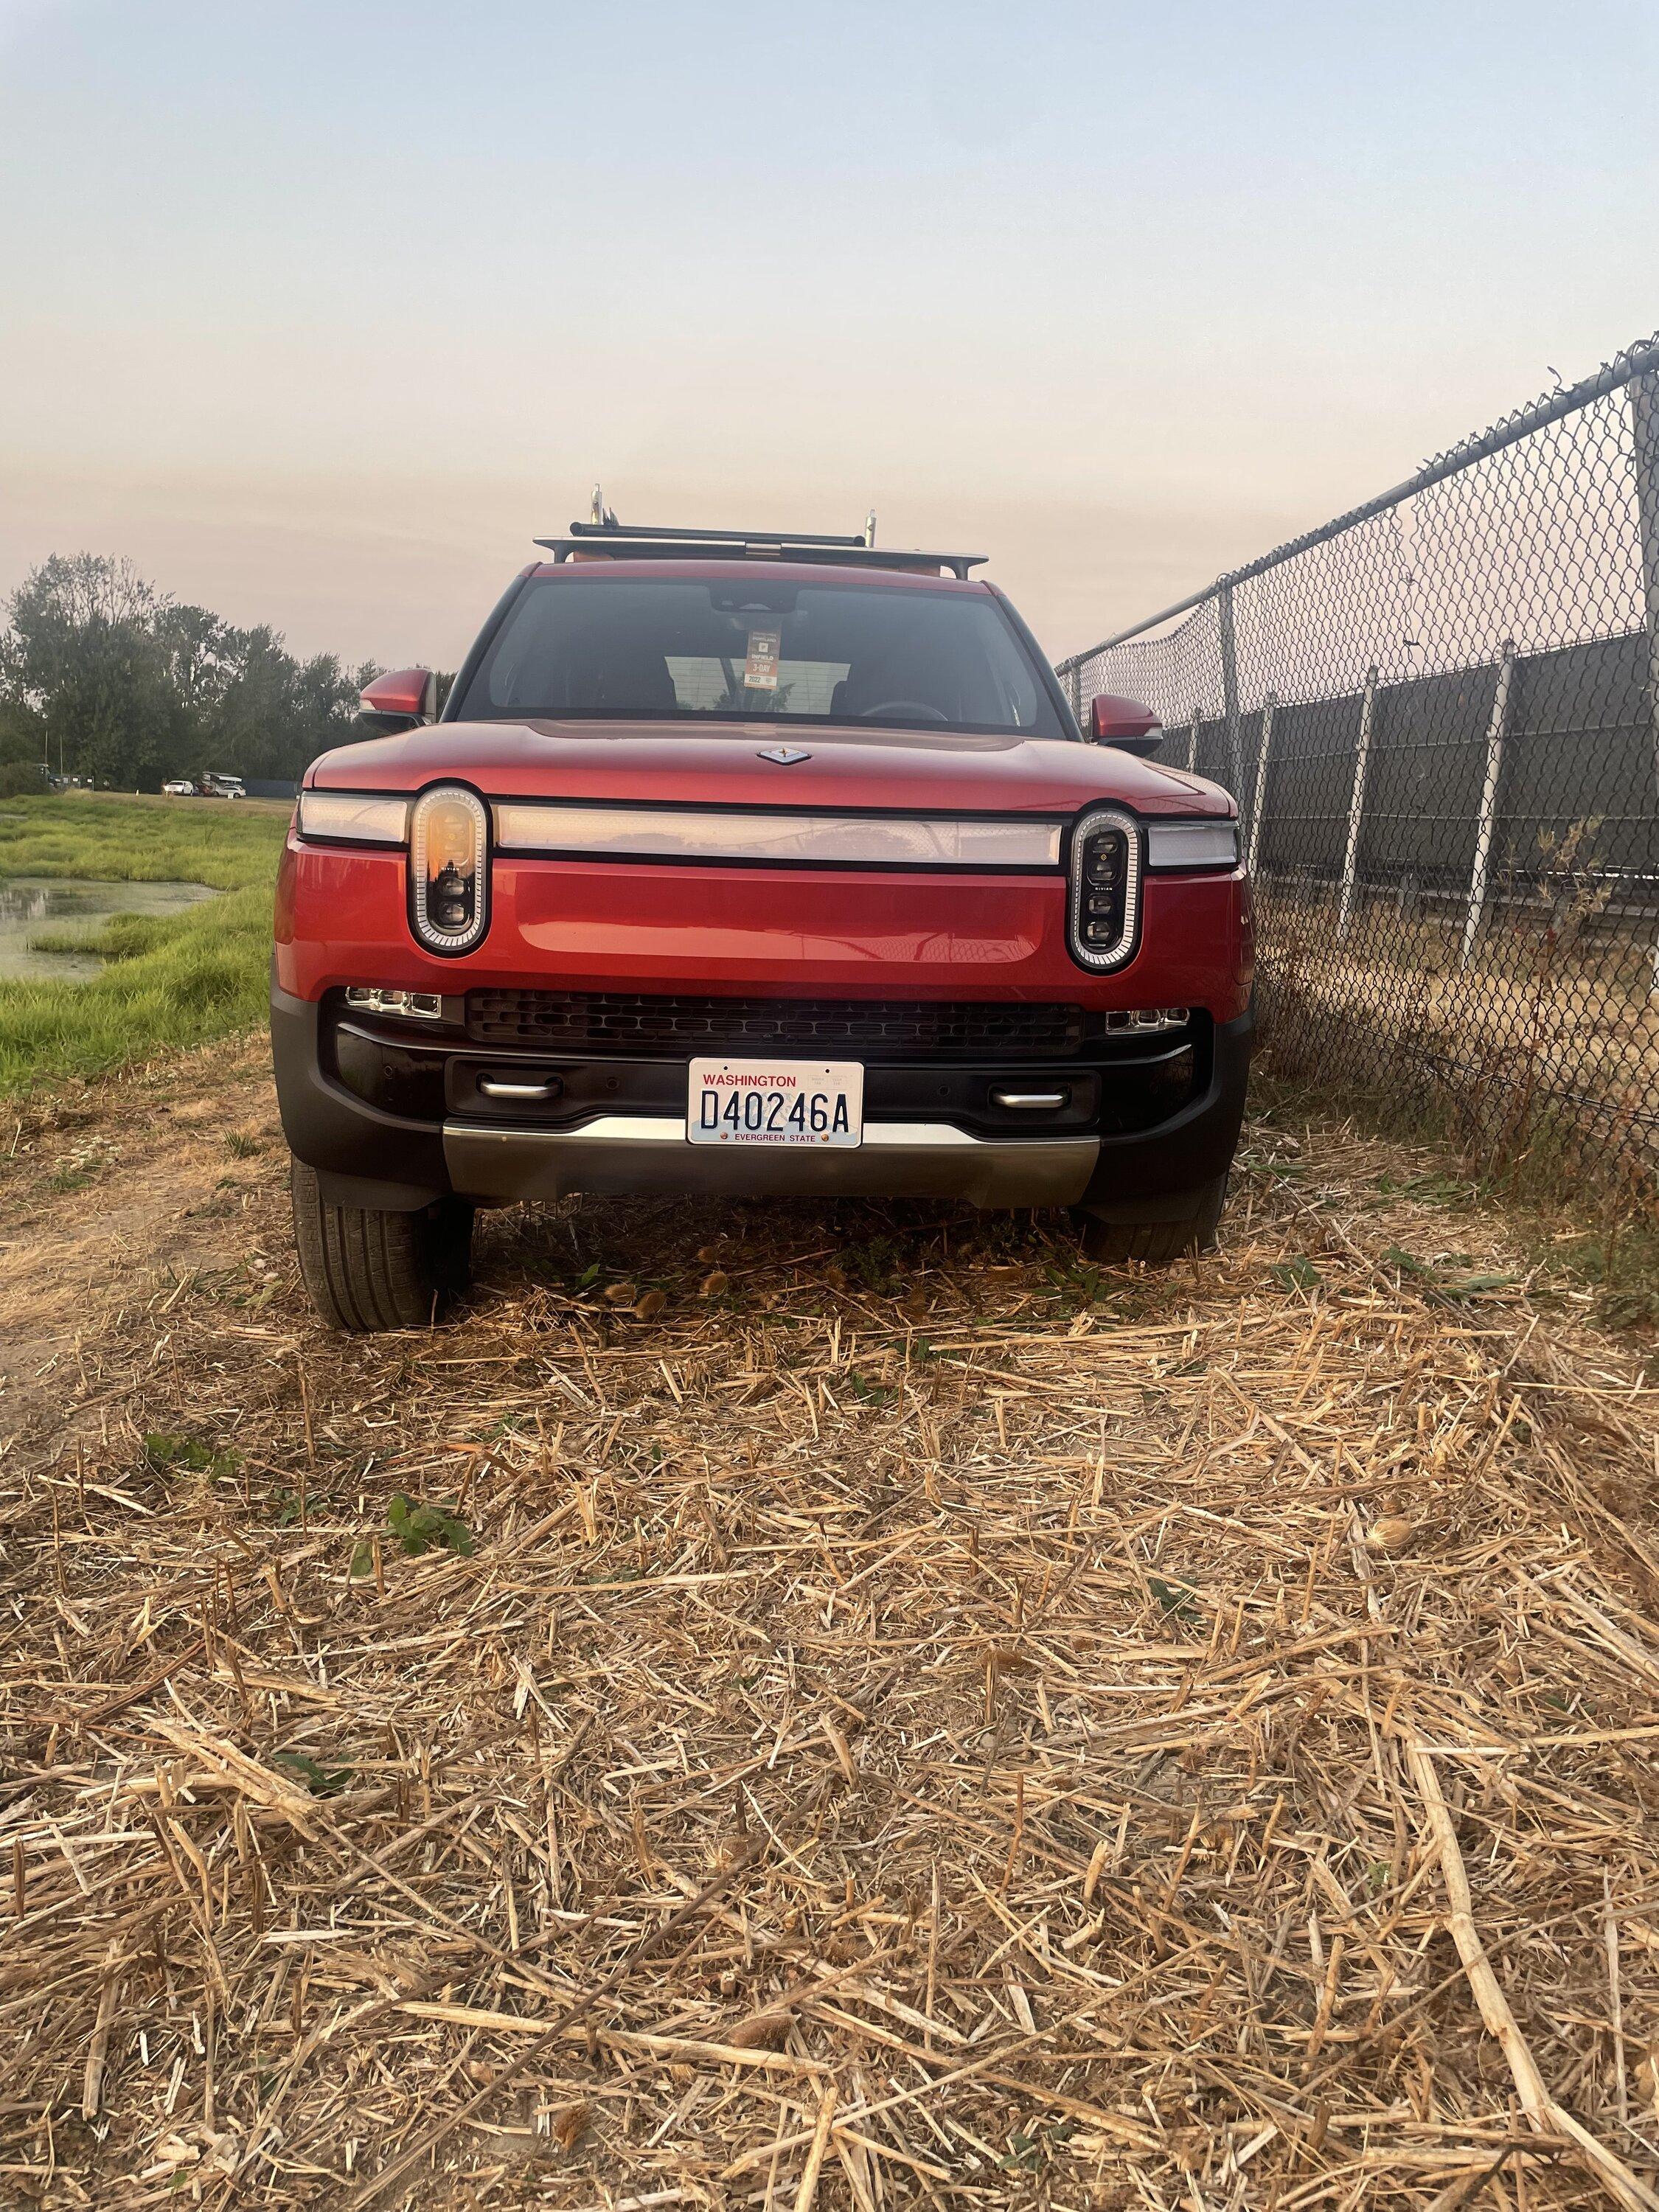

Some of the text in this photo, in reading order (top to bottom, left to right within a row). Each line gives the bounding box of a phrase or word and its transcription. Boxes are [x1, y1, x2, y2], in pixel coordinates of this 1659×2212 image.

[753, 664, 771, 672] 3-DAY
[703, 1074, 796, 1087] WASHINGTON
[700, 1090, 849, 1133] D40246A
[734, 1133, 816, 1142] EVERGREEN STATE
